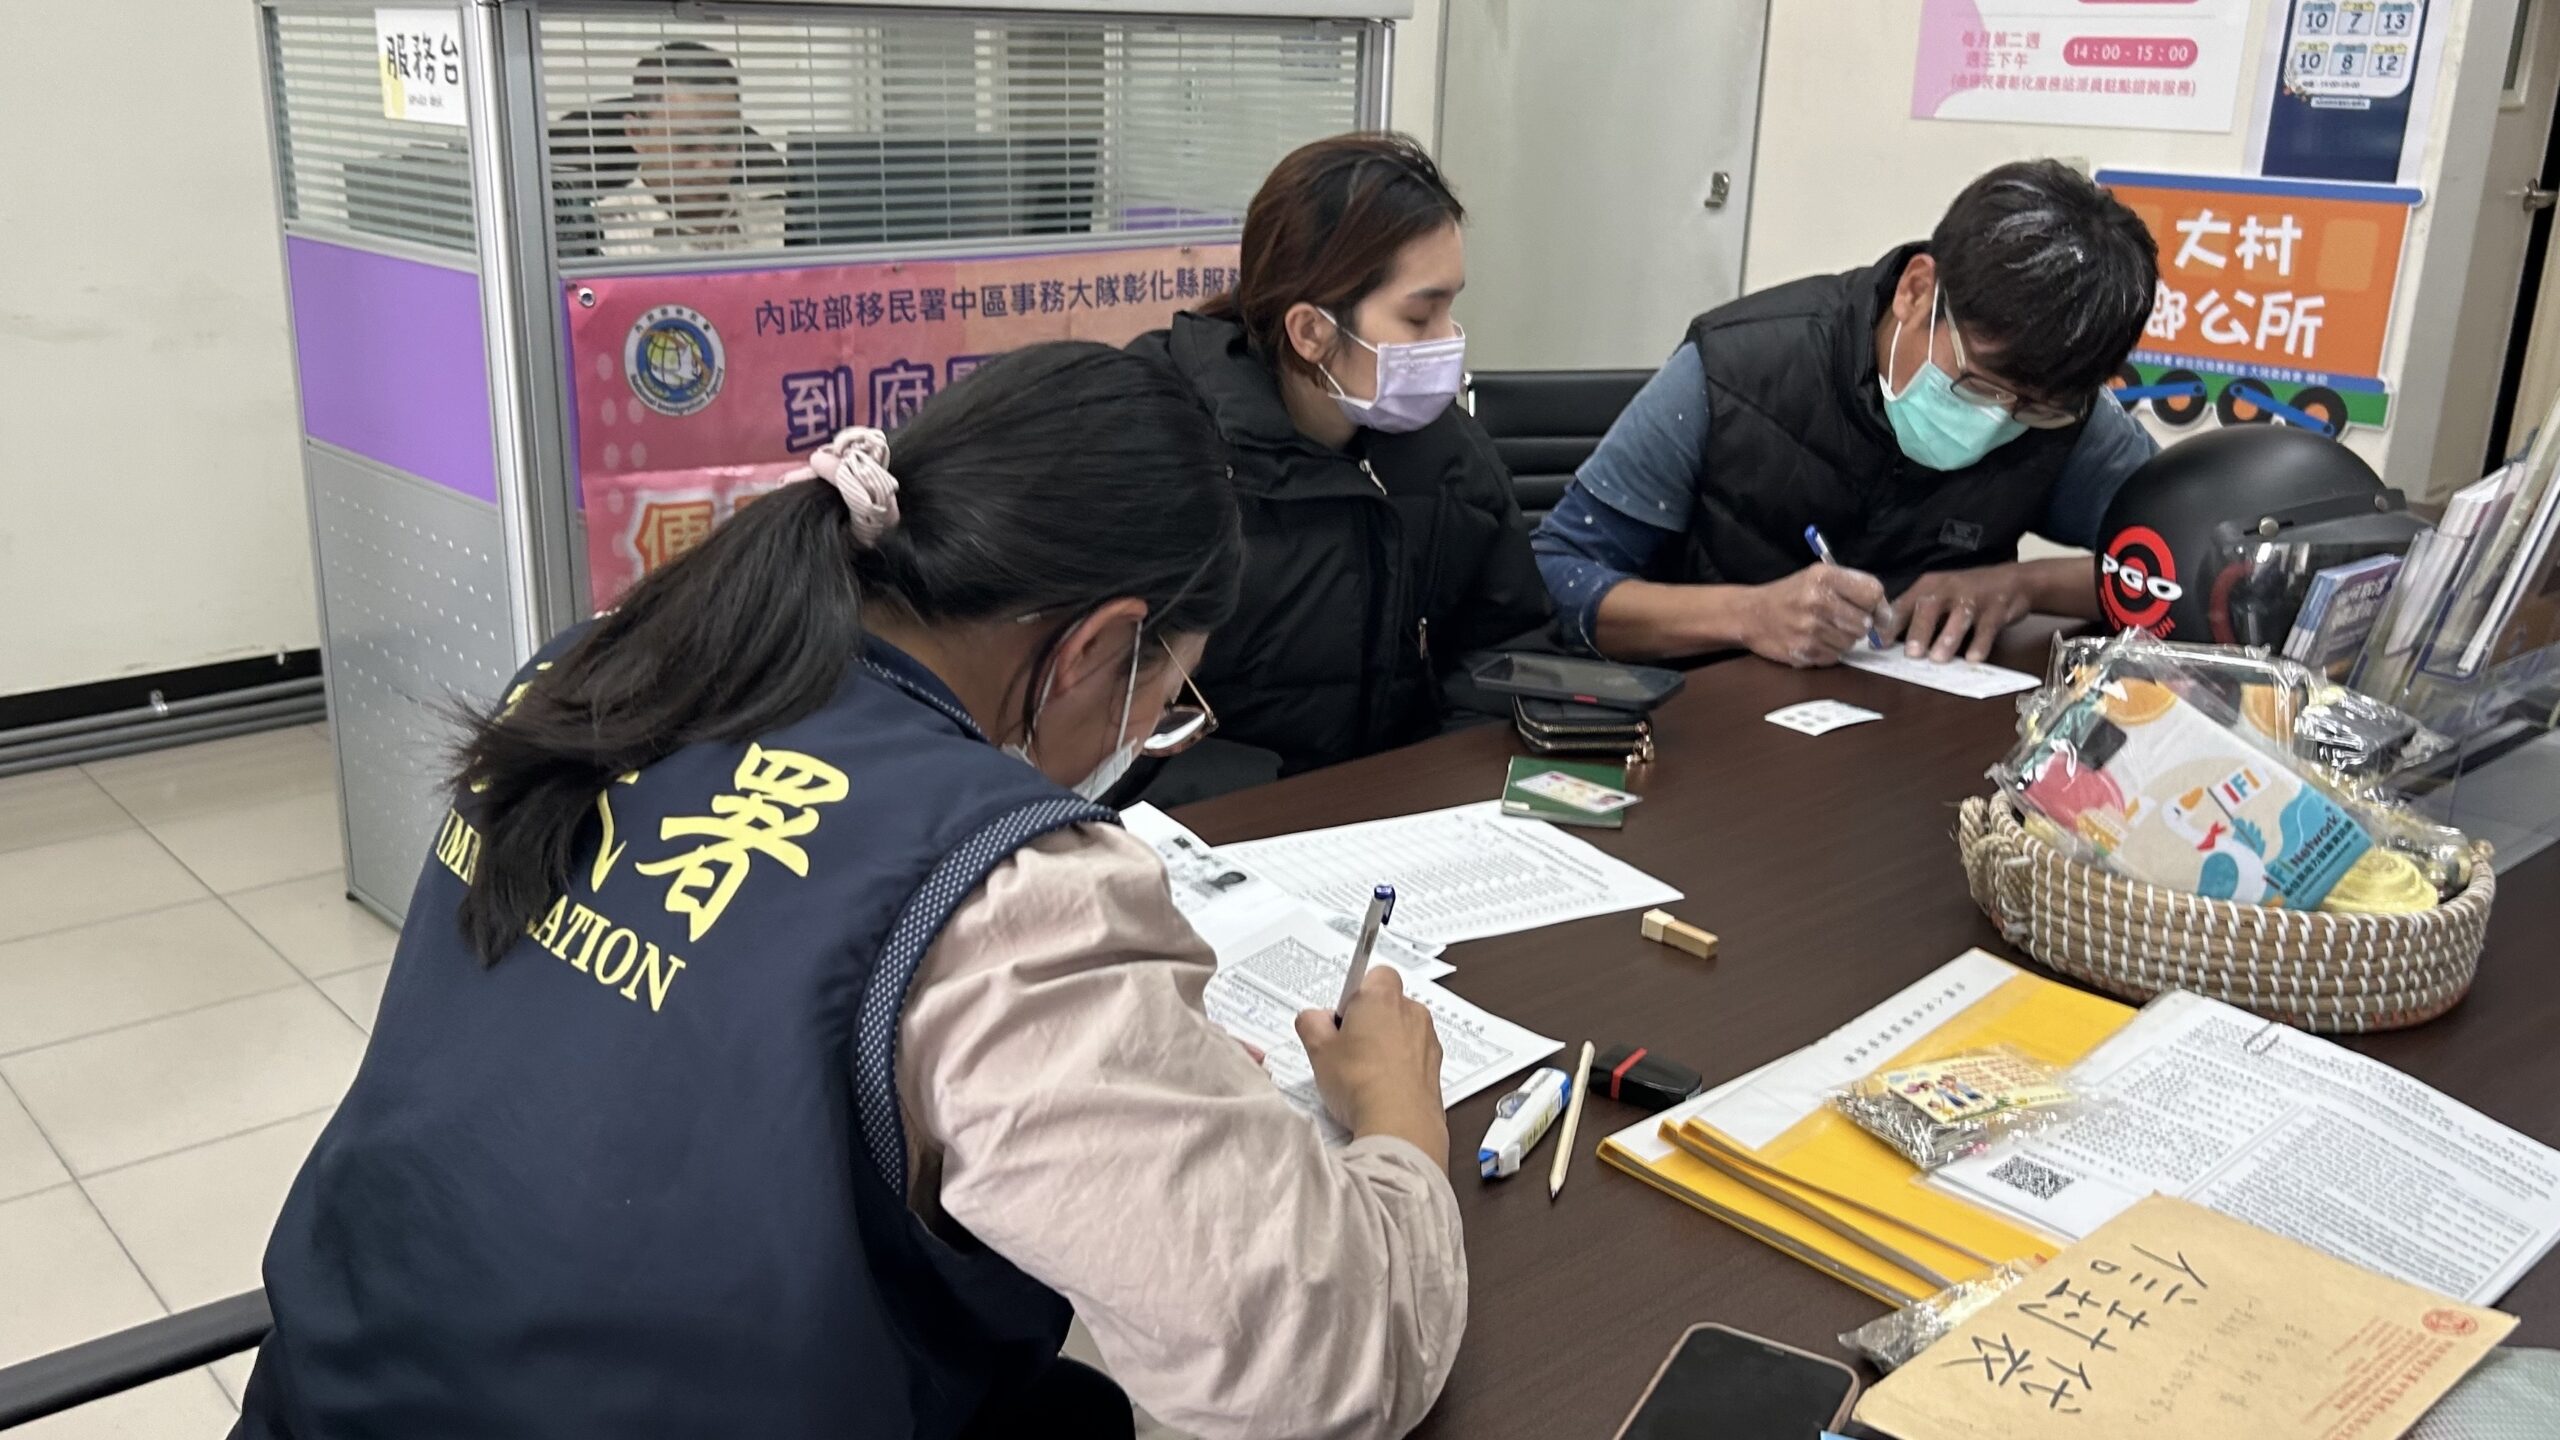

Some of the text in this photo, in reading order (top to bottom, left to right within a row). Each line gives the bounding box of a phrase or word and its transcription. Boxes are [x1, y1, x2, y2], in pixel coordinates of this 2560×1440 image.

[2305, 13, 2406, 30] 10 7 13
[385, 31, 460, 86] 服務台
[2299, 53, 2398, 71] 10 8 12
[2174, 208, 2303, 277] 大村
[784, 355, 995, 453] 到府
[2101, 552, 2184, 602] PGO
[2223, 767, 2262, 804] IFI
[434, 806, 687, 1013] IMATION
